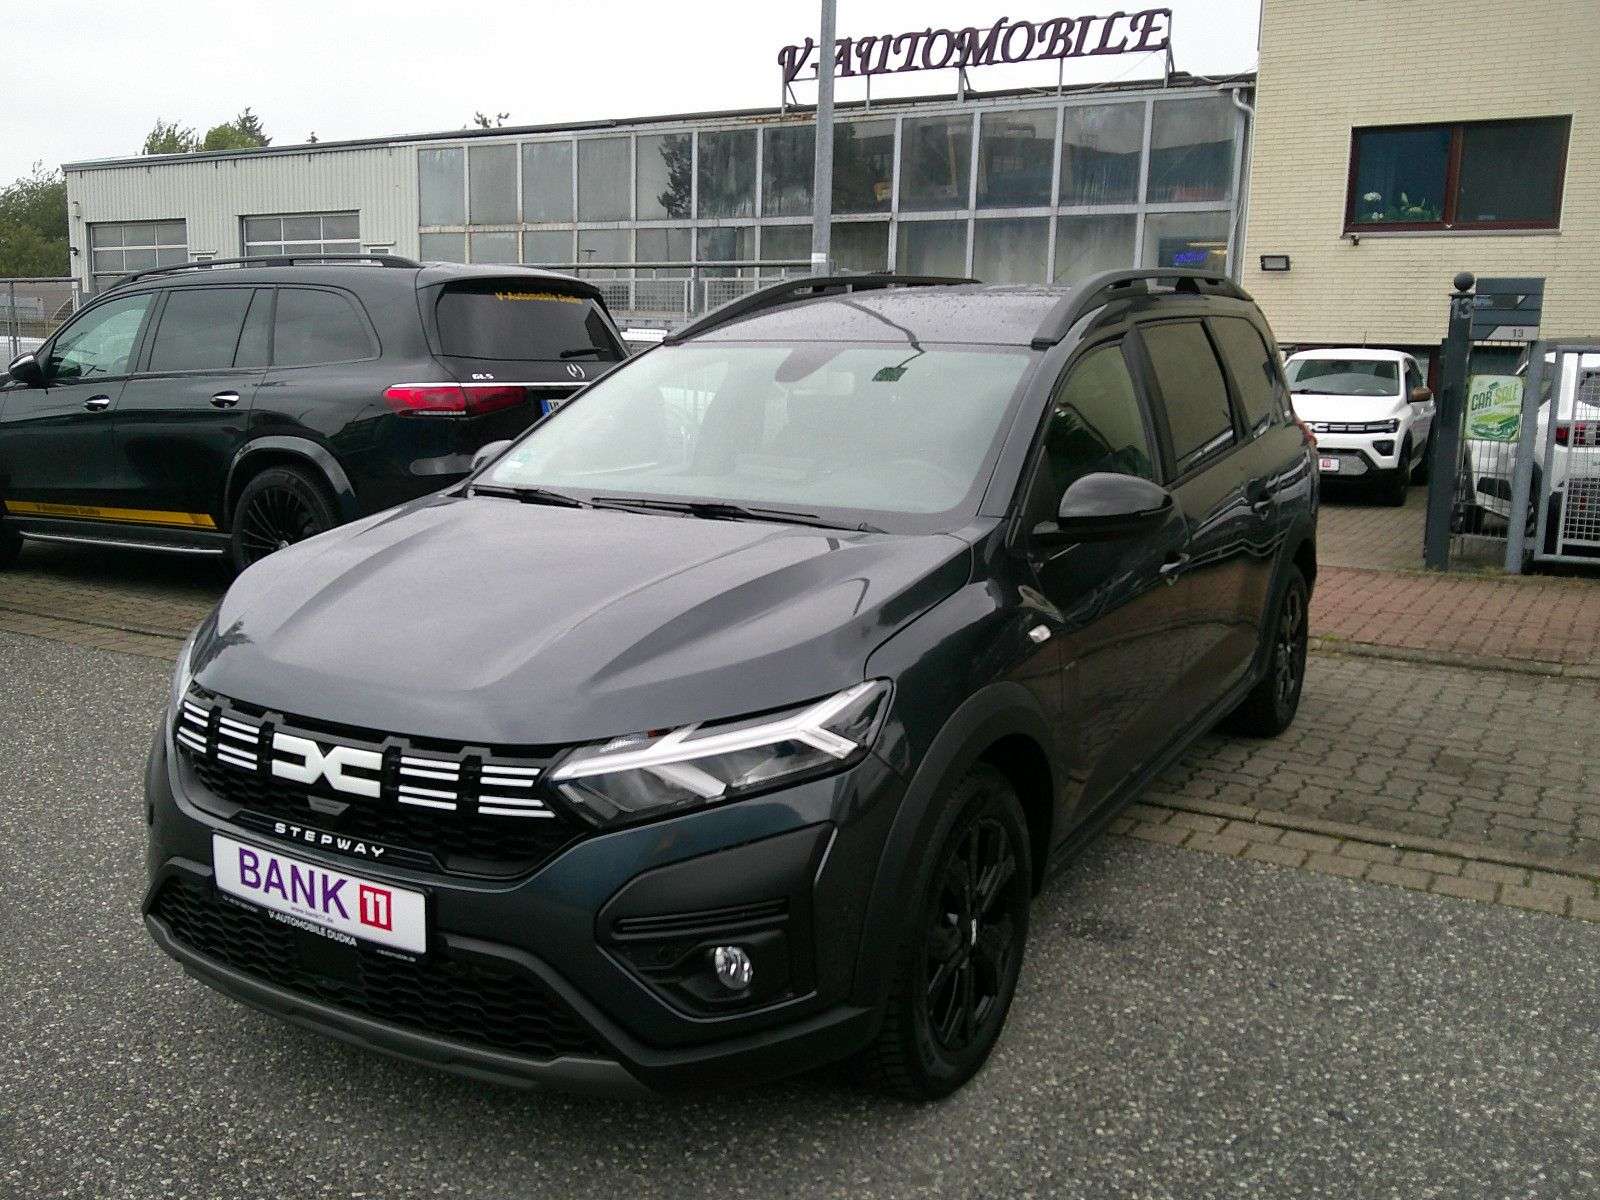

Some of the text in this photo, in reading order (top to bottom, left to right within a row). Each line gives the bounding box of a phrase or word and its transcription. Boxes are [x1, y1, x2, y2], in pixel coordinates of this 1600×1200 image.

[778, 8, 1171, 82] V-AUTOMOBILE
[1471, 389, 1492, 411] CAR
[274, 822, 385, 858] STEPWAY
[238, 846, 350, 920] BANK
[327, 928, 358, 947] DUDKA
